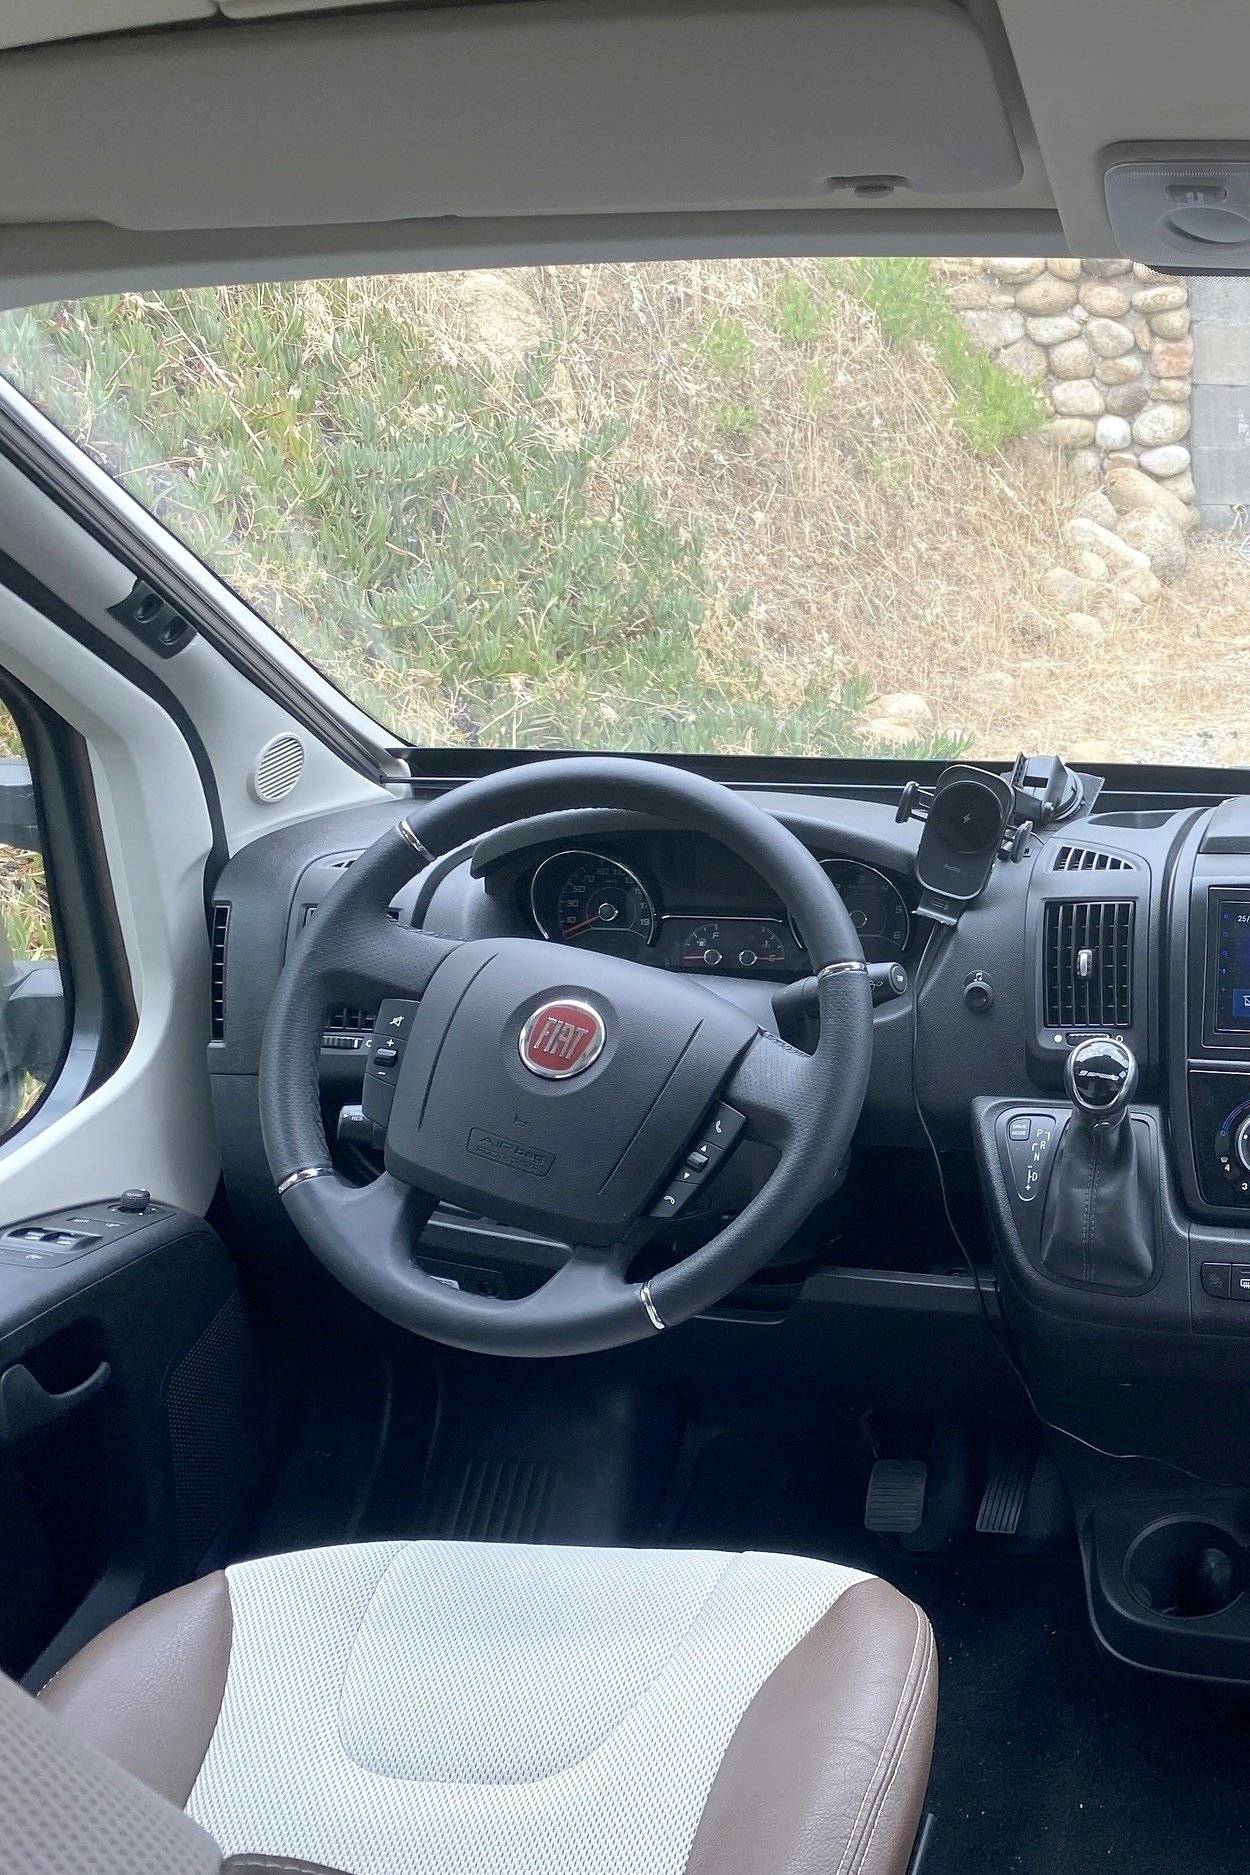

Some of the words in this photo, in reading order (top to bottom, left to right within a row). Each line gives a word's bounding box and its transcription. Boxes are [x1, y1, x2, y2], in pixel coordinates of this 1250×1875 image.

[533, 1016, 590, 1060] FIAT
[1040, 1141, 1045, 1150] R
[1033, 1153, 1040, 1161] N
[1224, 1163, 1230, 1172] 4
